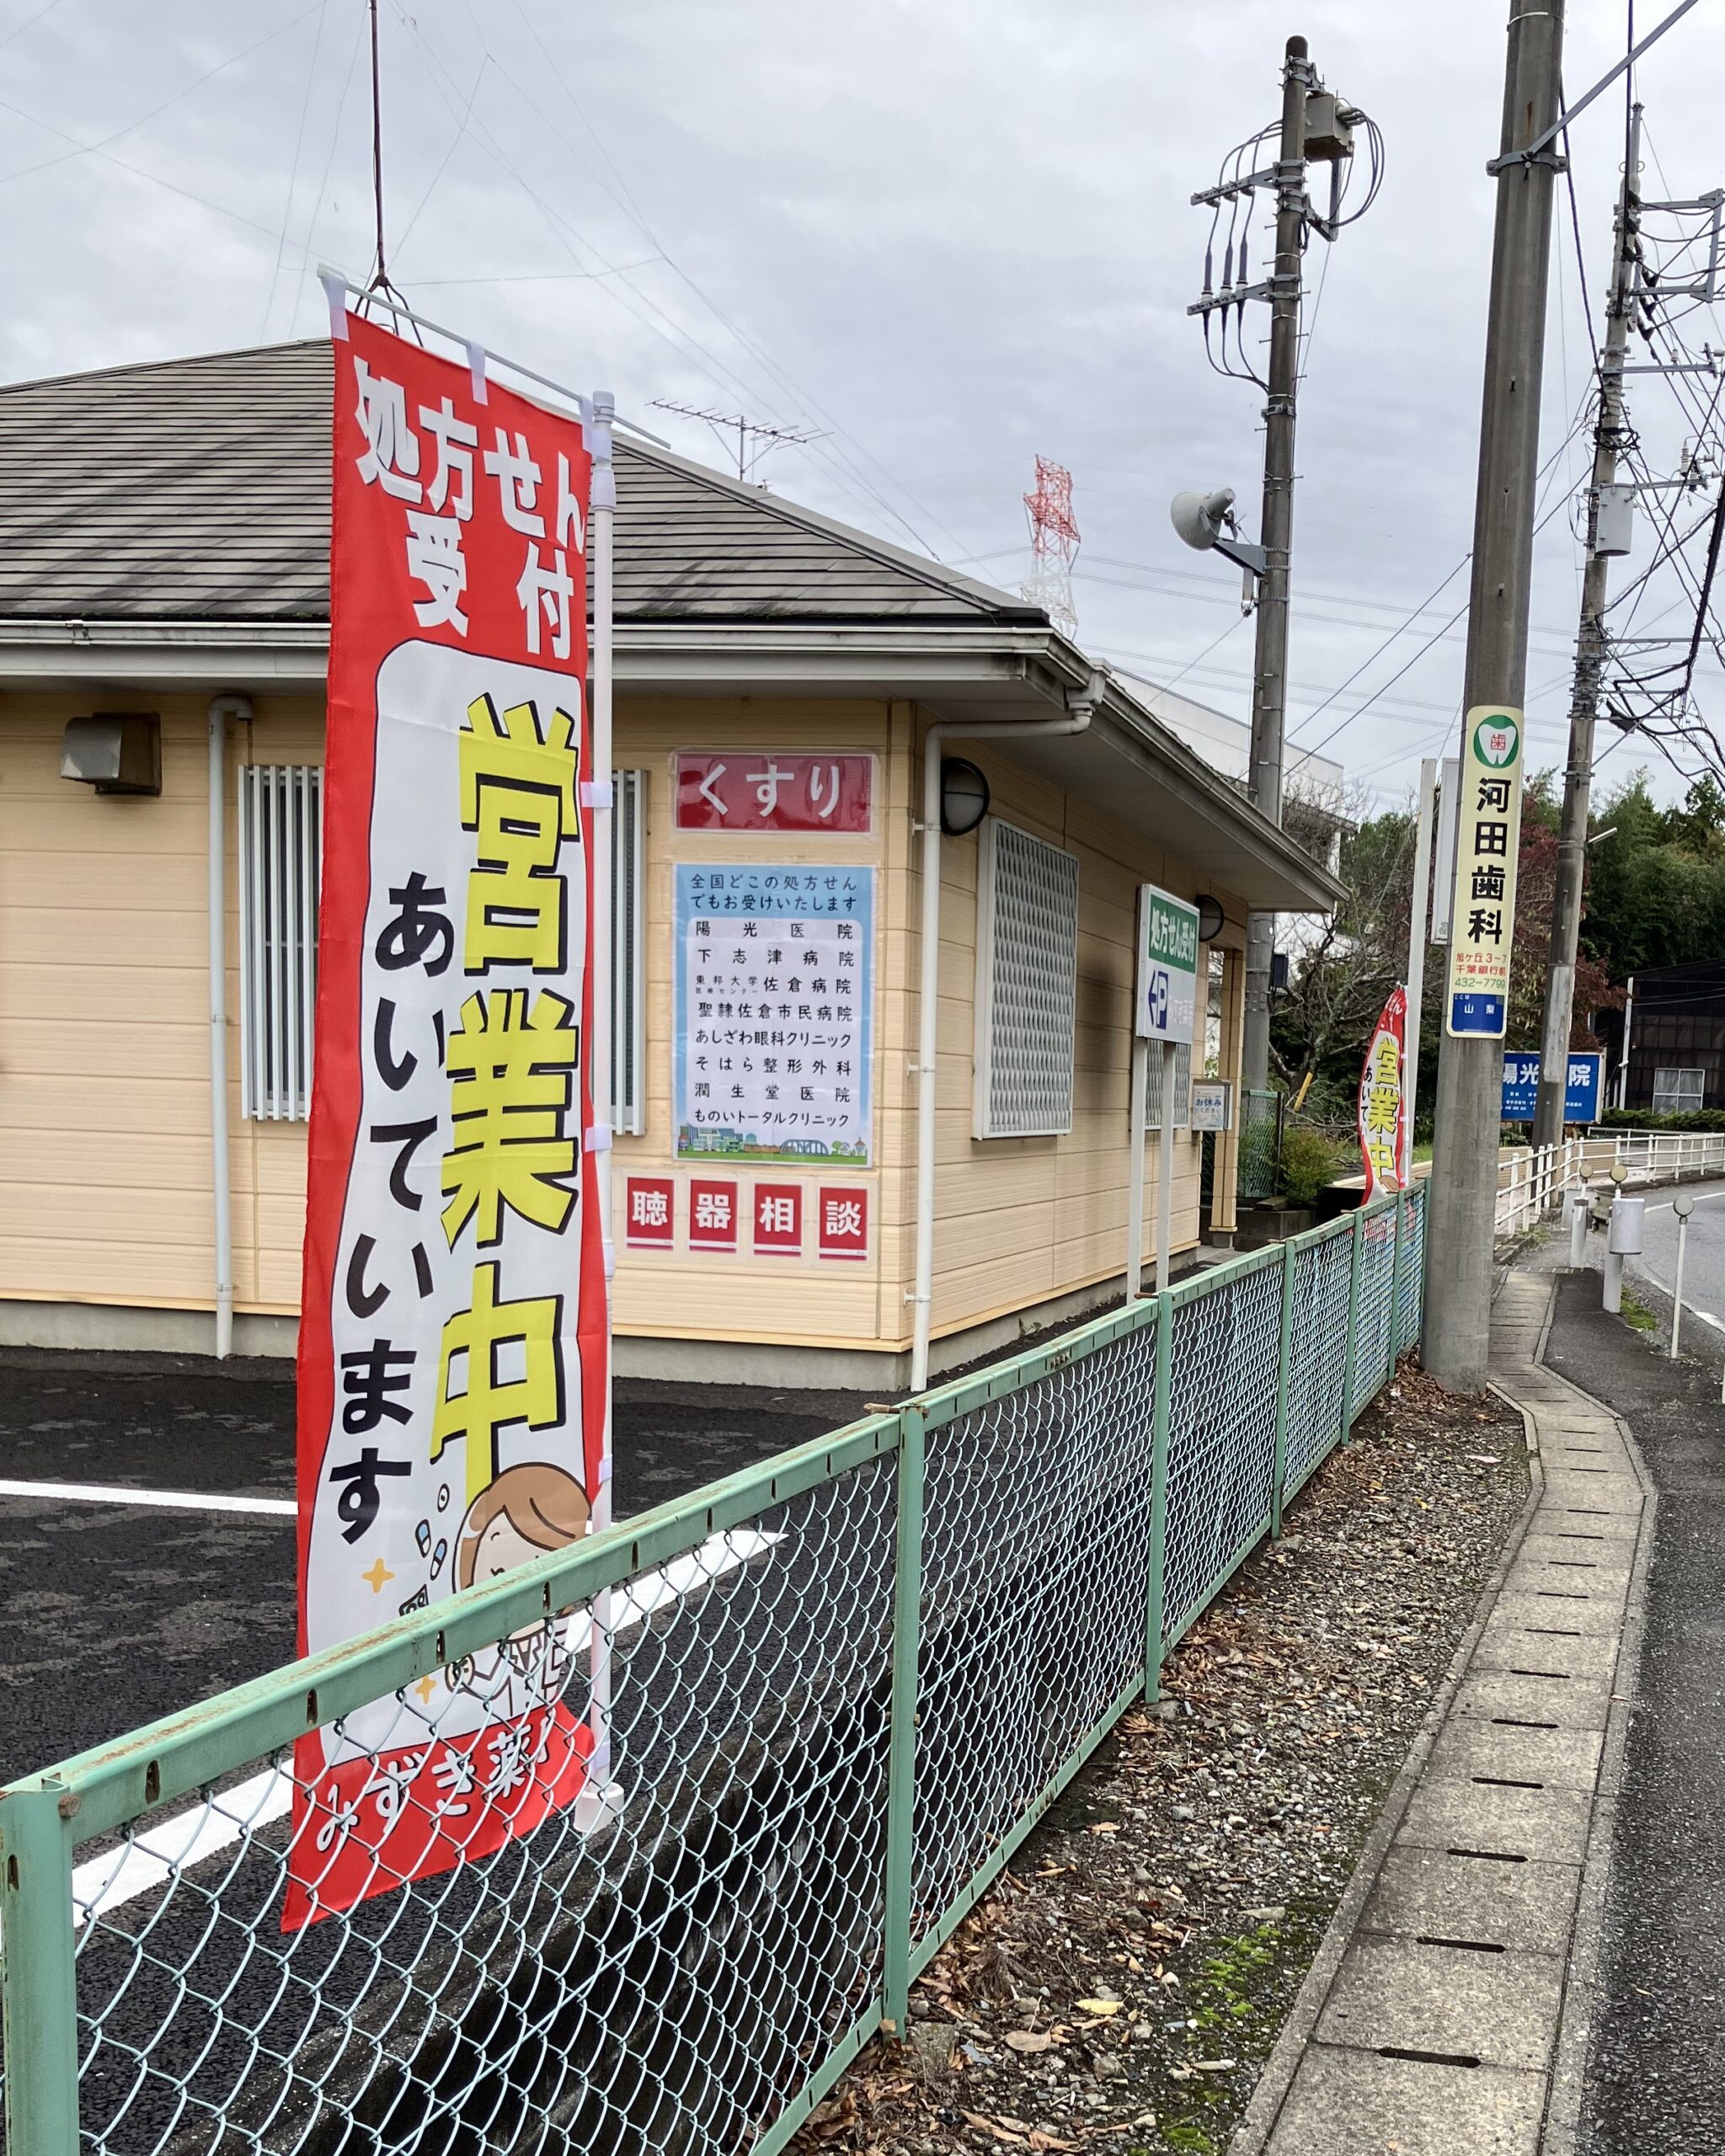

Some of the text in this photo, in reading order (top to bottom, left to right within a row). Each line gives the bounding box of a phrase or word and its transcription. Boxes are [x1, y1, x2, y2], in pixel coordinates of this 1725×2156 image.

[354, 354, 587, 556] 処方せん
[405, 509, 574, 660] 受付
[1490, 734, 1507, 751] 歯
[697, 763, 841, 819] くすり
[1467, 776, 1512, 945] 河田歯科
[690, 873, 857, 891] 全国どこの処方せん
[690, 894, 857, 912] でもお受けいたします
[696, 921, 853, 940] 陽光医院
[1151, 906, 1196, 963] 処方せん受付
[697, 947, 855, 968] 下志津病院
[1455, 964, 1506, 976] 千葉銀行前
[696, 975, 758, 987] 東邦大学
[763, 977, 852, 995] 佐倉病院
[698, 1001, 852, 1022] 聖隷佐倉市民病院
[1464, 1003, 1495, 1015] 山梨
[696, 1029, 852, 1049] あしざわ眼科クリニック
[696, 1056, 852, 1076] そはら整形外科
[1503, 1062, 1591, 1087] 陽光院
[430, 691, 581, 1509] 営業中
[694, 1082, 851, 1102] 潤生堂医院
[1368, 1037, 1400, 1179] 営業中
[694, 1110, 849, 1128] ものいトータルクリニック
[329, 871, 455, 1545] あいています
